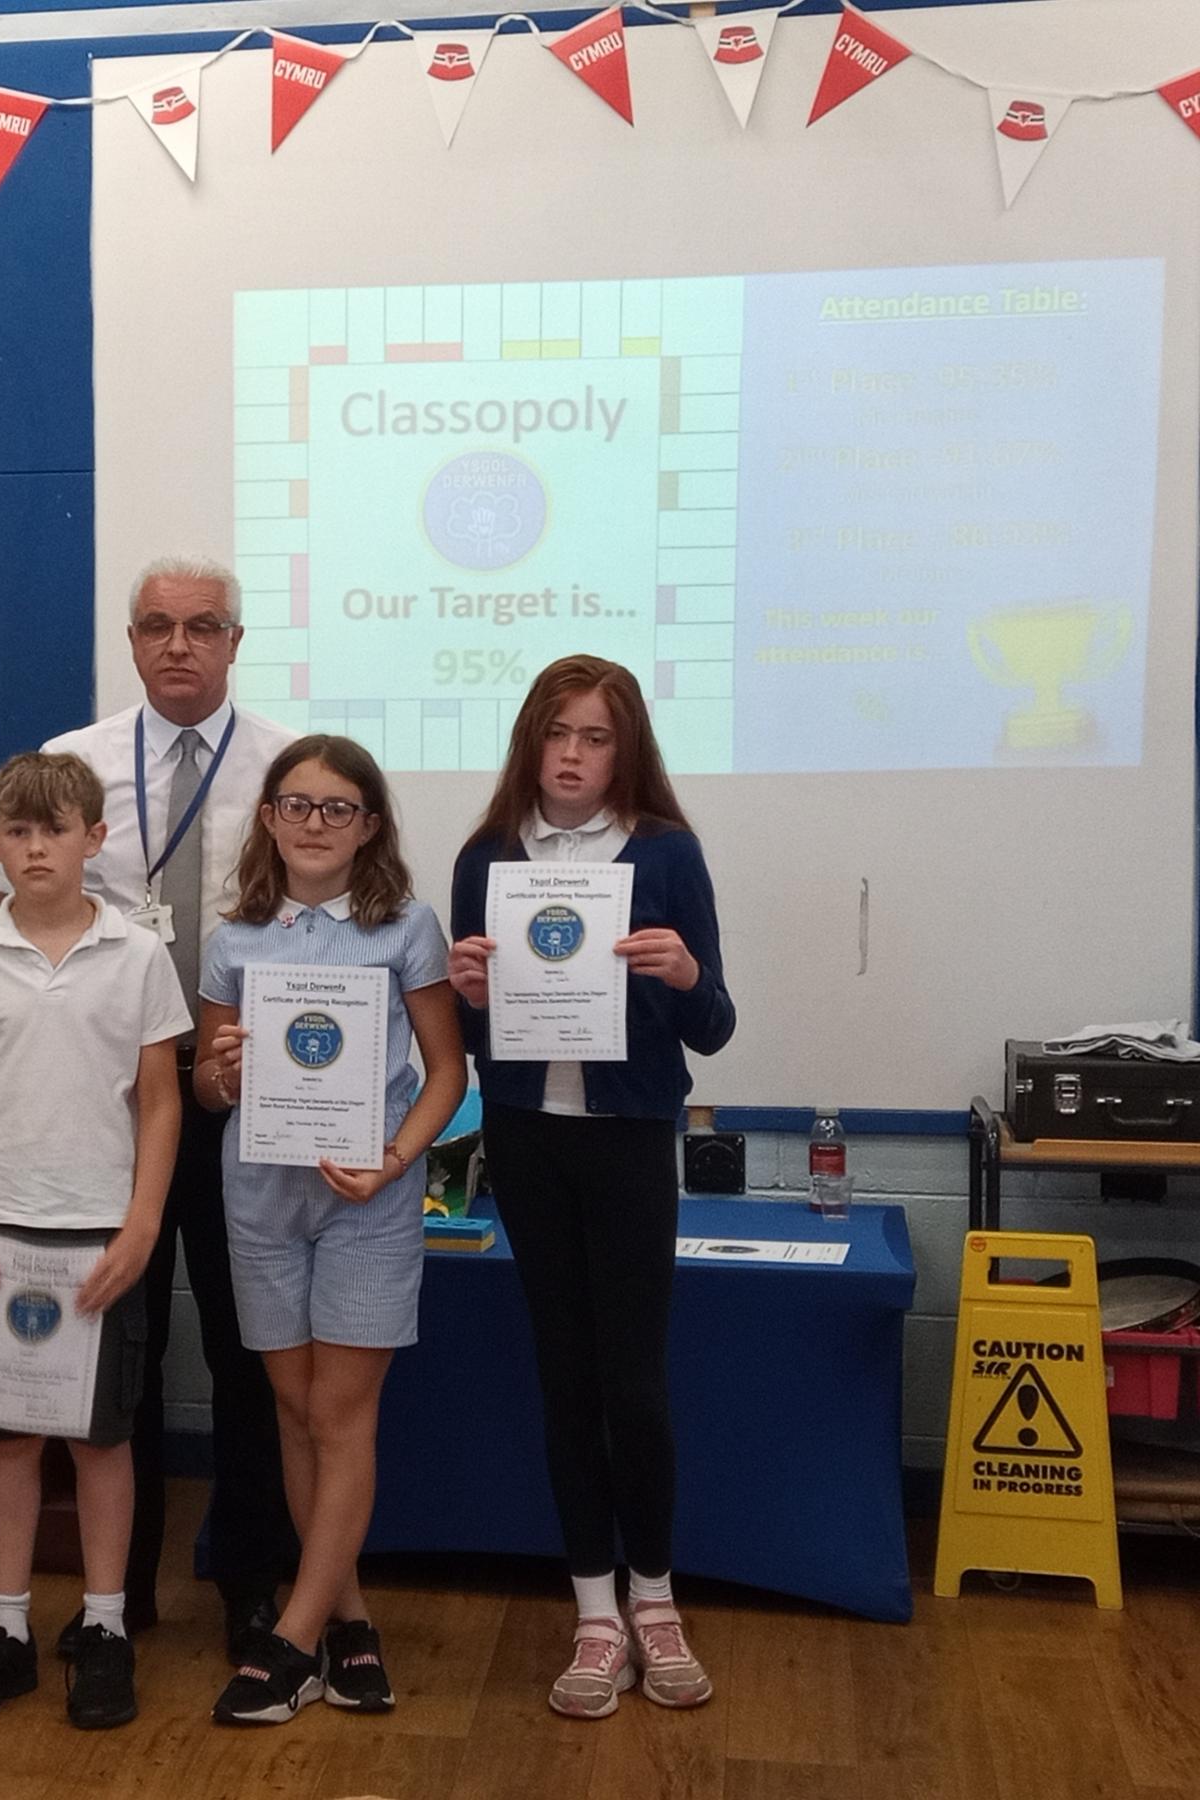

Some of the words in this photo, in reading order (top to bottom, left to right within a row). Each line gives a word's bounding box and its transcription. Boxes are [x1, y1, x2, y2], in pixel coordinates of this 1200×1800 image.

[568, 31, 623, 72] CYMRU
[834, 33, 889, 76] CYMRU
[274, 59, 326, 90] CYMRU
[820, 290, 989, 321] Attendance
[1001, 285, 1088, 313] Table:
[341, 385, 627, 442] Classopoly
[342, 587, 418, 621] Our
[430, 585, 558, 625] Target
[571, 584, 638, 618] is...
[432, 649, 527, 686] 95%
[973, 1340, 1084, 1361] CAUTION
[973, 1461, 1083, 1482] CLEANING
[973, 1478, 992, 1491] IN
[997, 1481, 1084, 1497] PROGRESS
